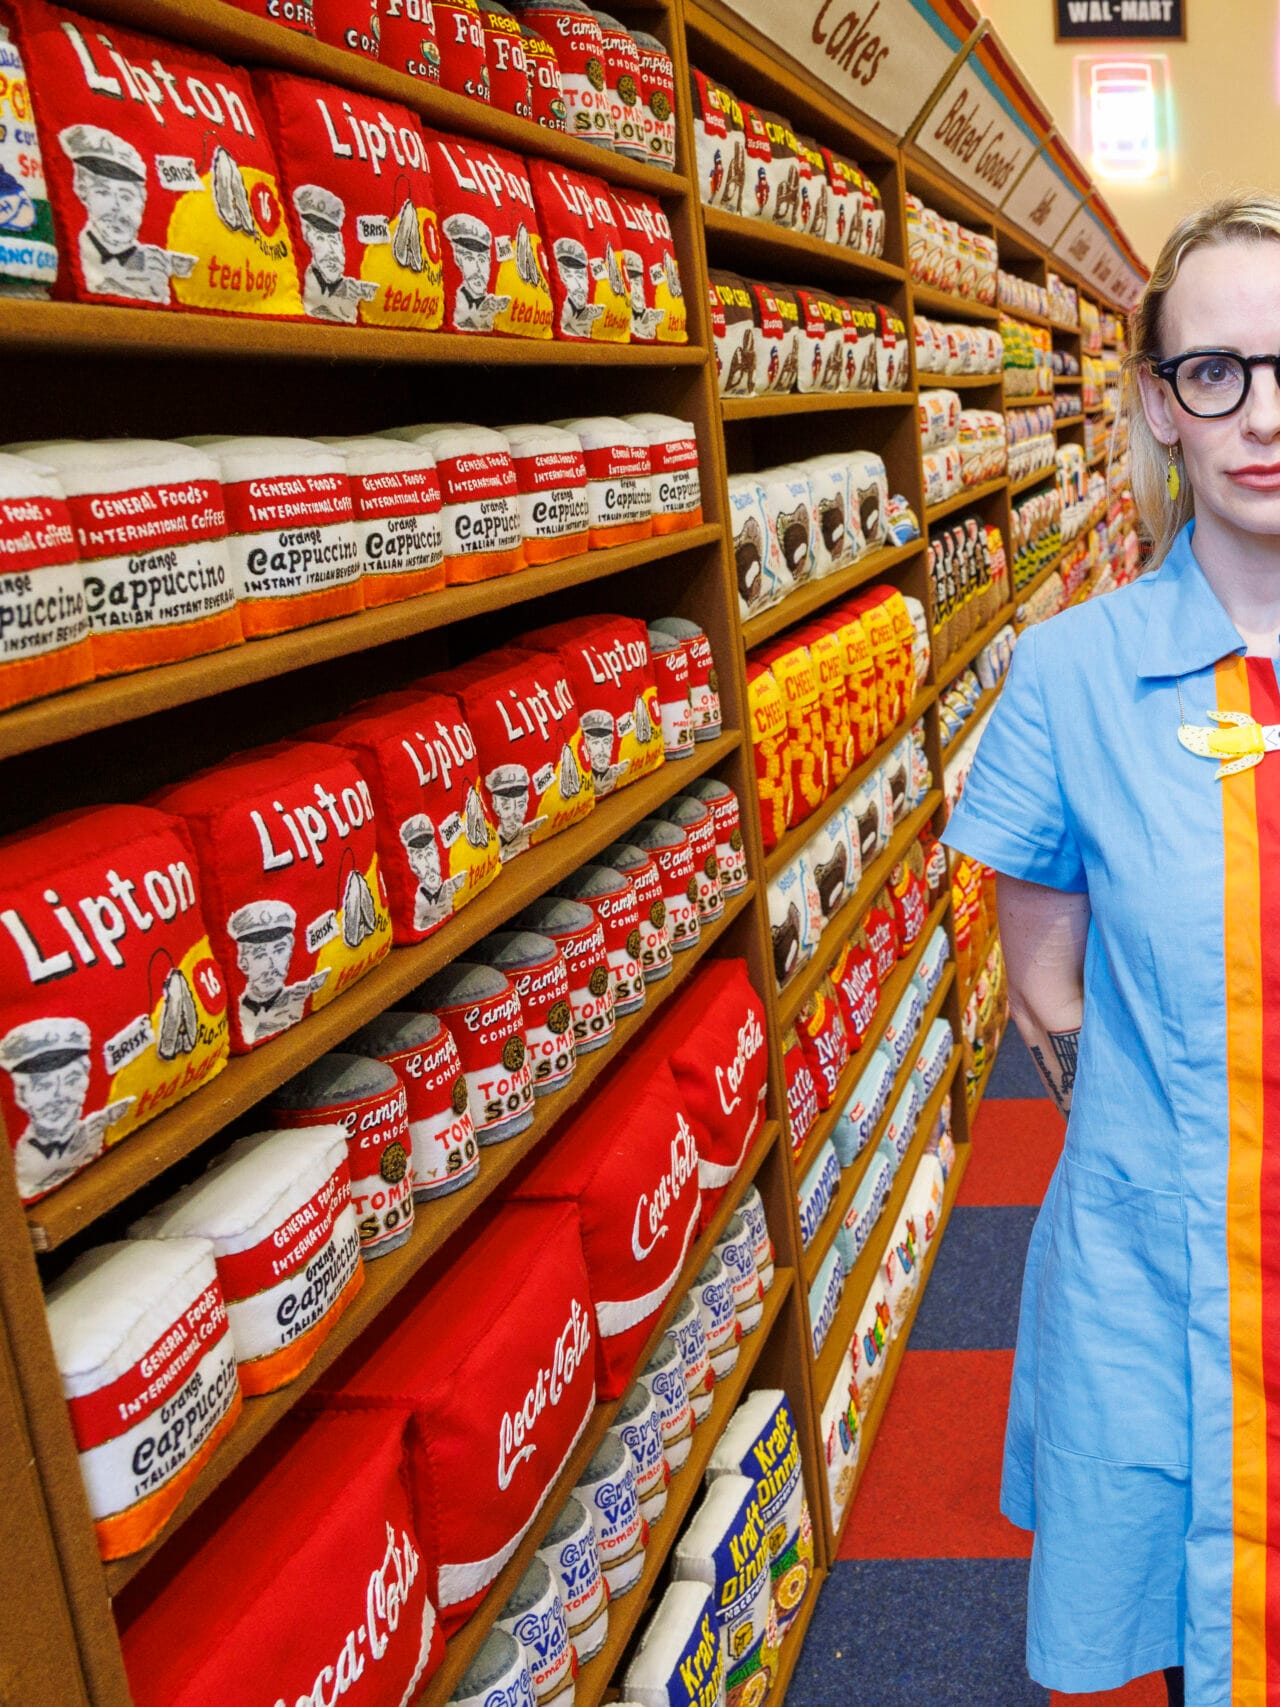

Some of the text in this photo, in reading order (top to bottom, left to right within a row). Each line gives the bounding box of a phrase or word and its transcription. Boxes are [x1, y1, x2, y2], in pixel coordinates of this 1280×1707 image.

[60, 21, 256, 140] Lipton
[317, 98, 431, 176] Lipton
[208, 254, 278, 300] tea bags
[383, 287, 439, 319] tea bags
[510, 296, 532, 322] tea
[362, 475, 403, 491] GENERAL
[456, 458, 489, 473] GENERAL
[90, 492, 157, 519] GENERAL
[249, 480, 307, 498] GENERAL
[360, 490, 420, 512] INTERNATIONAL
[480, 499, 509, 514] Orange
[551, 489, 574, 502] Orange
[78, 515, 189, 547] INTERNATIONAL
[249, 500, 335, 522] INTERNATIONAL
[387, 517, 417, 533] Orange
[247, 537, 358, 575] Cappuccino
[278, 529, 322, 548] Orange
[461, 538, 496, 553] ITALIAN
[128, 550, 178, 575] Orange
[244, 570, 336, 593] INSTANT ITALIAN
[363, 559, 403, 572] ITALIAN
[84, 560, 225, 612] Cappuccino
[88, 600, 202, 628] ITALIAN INSTANT
[582, 638, 648, 688] Lipton
[250, 779, 375, 873] Lipton
[0, 860, 197, 985] Lipton
[200, 967, 222, 999] 16
[716, 1008, 764, 1116] Coca-Cola
[134, 1073, 182, 1119] tea
[631, 1111, 699, 1262] Coca-Cola
[273, 1204, 319, 1249] GENERAL
[276, 1228, 360, 1326] Cappuccino
[305, 1239, 337, 1282] Orange
[281, 1303, 324, 1344] ITALIAN
[140, 1323, 188, 1379] GENERAL
[118, 1332, 202, 1421] INTERNATIONAL
[498, 1298, 591, 1492] Coca-Cola
[160, 1370, 204, 1425] Orange
[753, 1406, 793, 1473] Kraft
[134, 1448, 186, 1497] ITALIAN
[728, 1499, 766, 1575] Kraft
